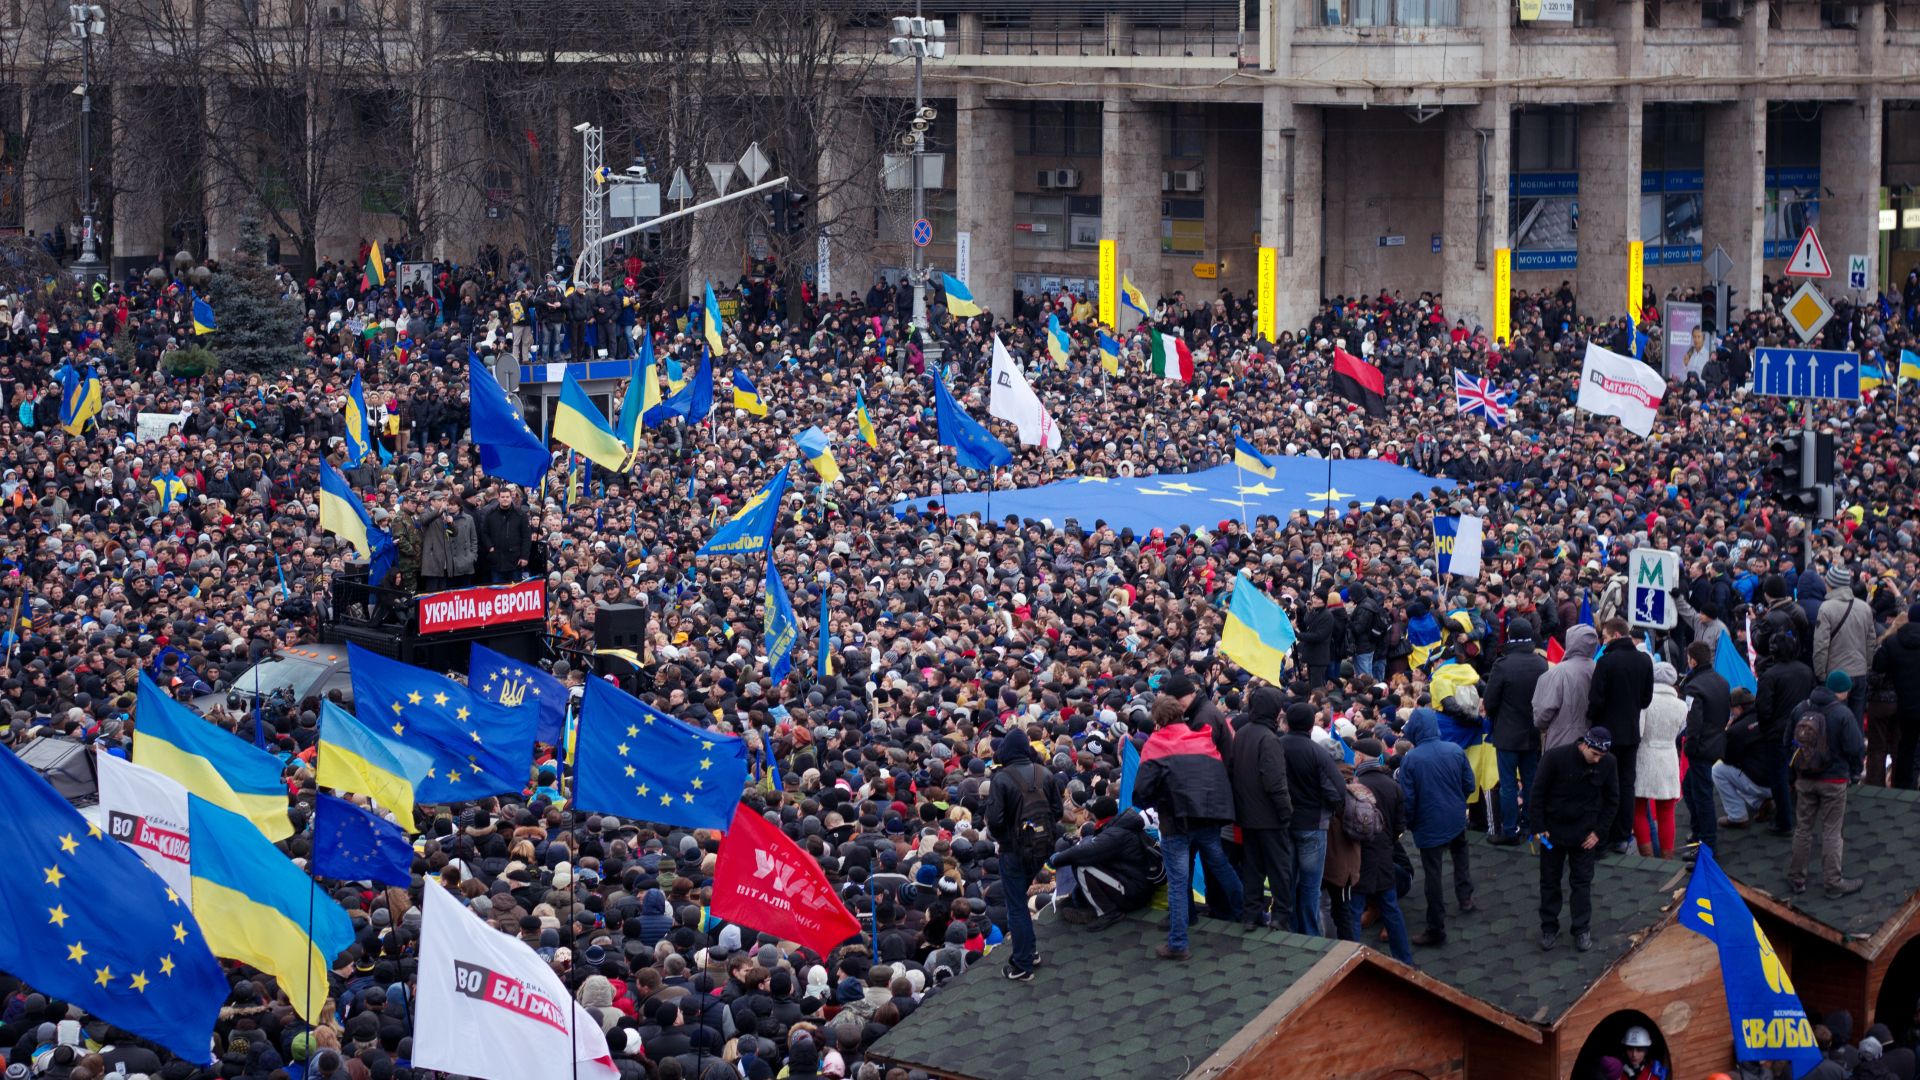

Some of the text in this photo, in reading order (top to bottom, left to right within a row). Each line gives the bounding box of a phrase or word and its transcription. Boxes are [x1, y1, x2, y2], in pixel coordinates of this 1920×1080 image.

[1548, 2, 1558, 10] 220
[1520, 181, 1556, 189] МОБІЛЬНІ
[1519, 255, 1577, 264] MOYO.UA MOY
[1262, 254, 1270, 337] НЕРГОБАНК
[1592, 371, 1603, 384] ВО
[1435, 535, 1456, 555] НО
[424, 589, 541, 625] УКРАЇНА це ЄВРОПА
[112, 816, 134, 837] ВО
[736, 884, 791, 912] ВІТАЛІЯ
[457, 966, 483, 993] ВО
[1742, 1018, 1818, 1049] СВОБО
